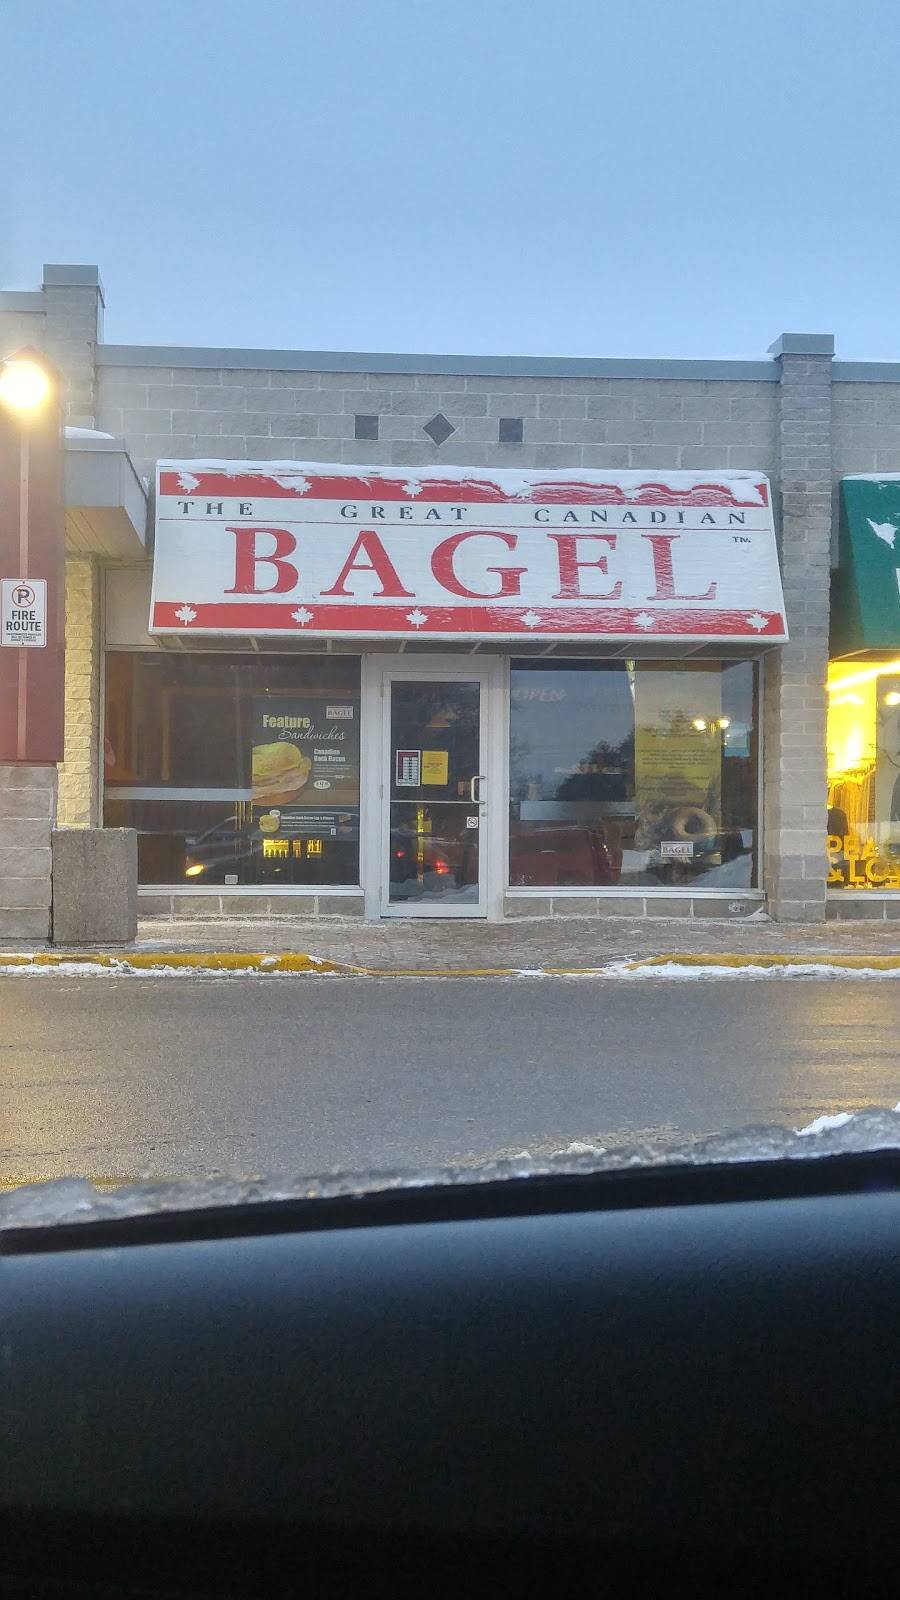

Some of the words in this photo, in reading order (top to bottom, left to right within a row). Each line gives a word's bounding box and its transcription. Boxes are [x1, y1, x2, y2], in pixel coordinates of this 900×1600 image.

[178, 501, 253, 516] THE
[341, 504, 468, 520] GREAT
[534, 508, 746, 525] CANADIAN
[223, 526, 717, 601] BAGEL
[11, 610, 36, 621] FIRE
[6, 621, 42, 632] ROUTE
[262, 714, 311, 729] Feature
[278, 724, 345, 741] Sandwiches
[662, 846, 692, 854] BAGEL
